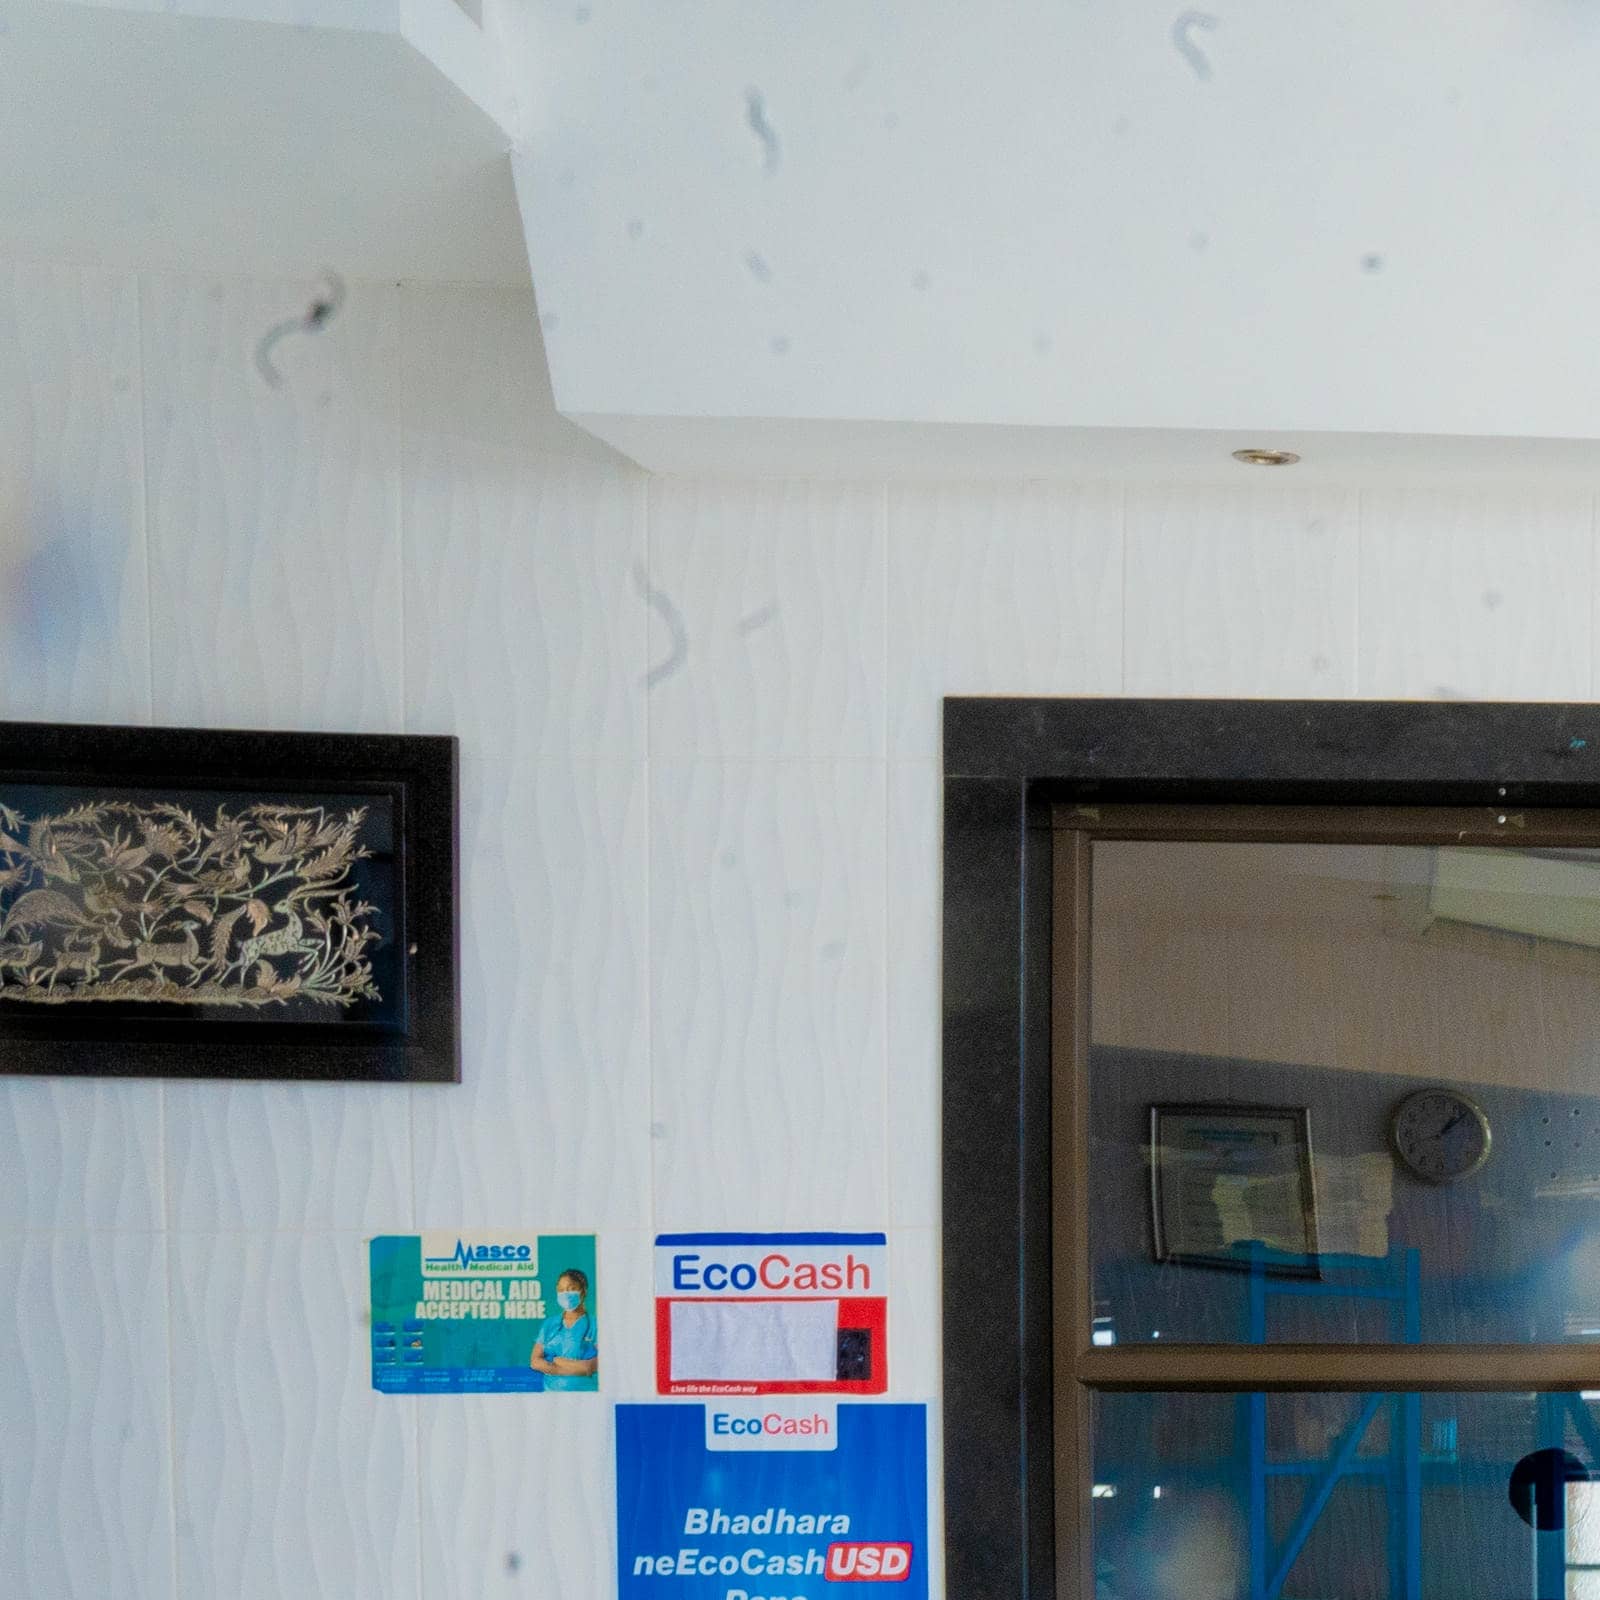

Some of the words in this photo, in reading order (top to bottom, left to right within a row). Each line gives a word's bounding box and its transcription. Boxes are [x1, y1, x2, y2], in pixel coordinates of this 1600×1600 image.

[426, 1262, 464, 1272] Health
[470, 1262, 513, 1272] Medical
[517, 1262, 535, 1272] Aid
[673, 1254, 871, 1290] EcoCash
[423, 1280, 506, 1301] MEDICAL
[508, 1280, 543, 1300] AID
[415, 1300, 501, 1320] ACCEPTED
[504, 1300, 547, 1320] HERE
[713, 1413, 829, 1435] EcoCash
[684, 1508, 850, 1535] Bhadhara
